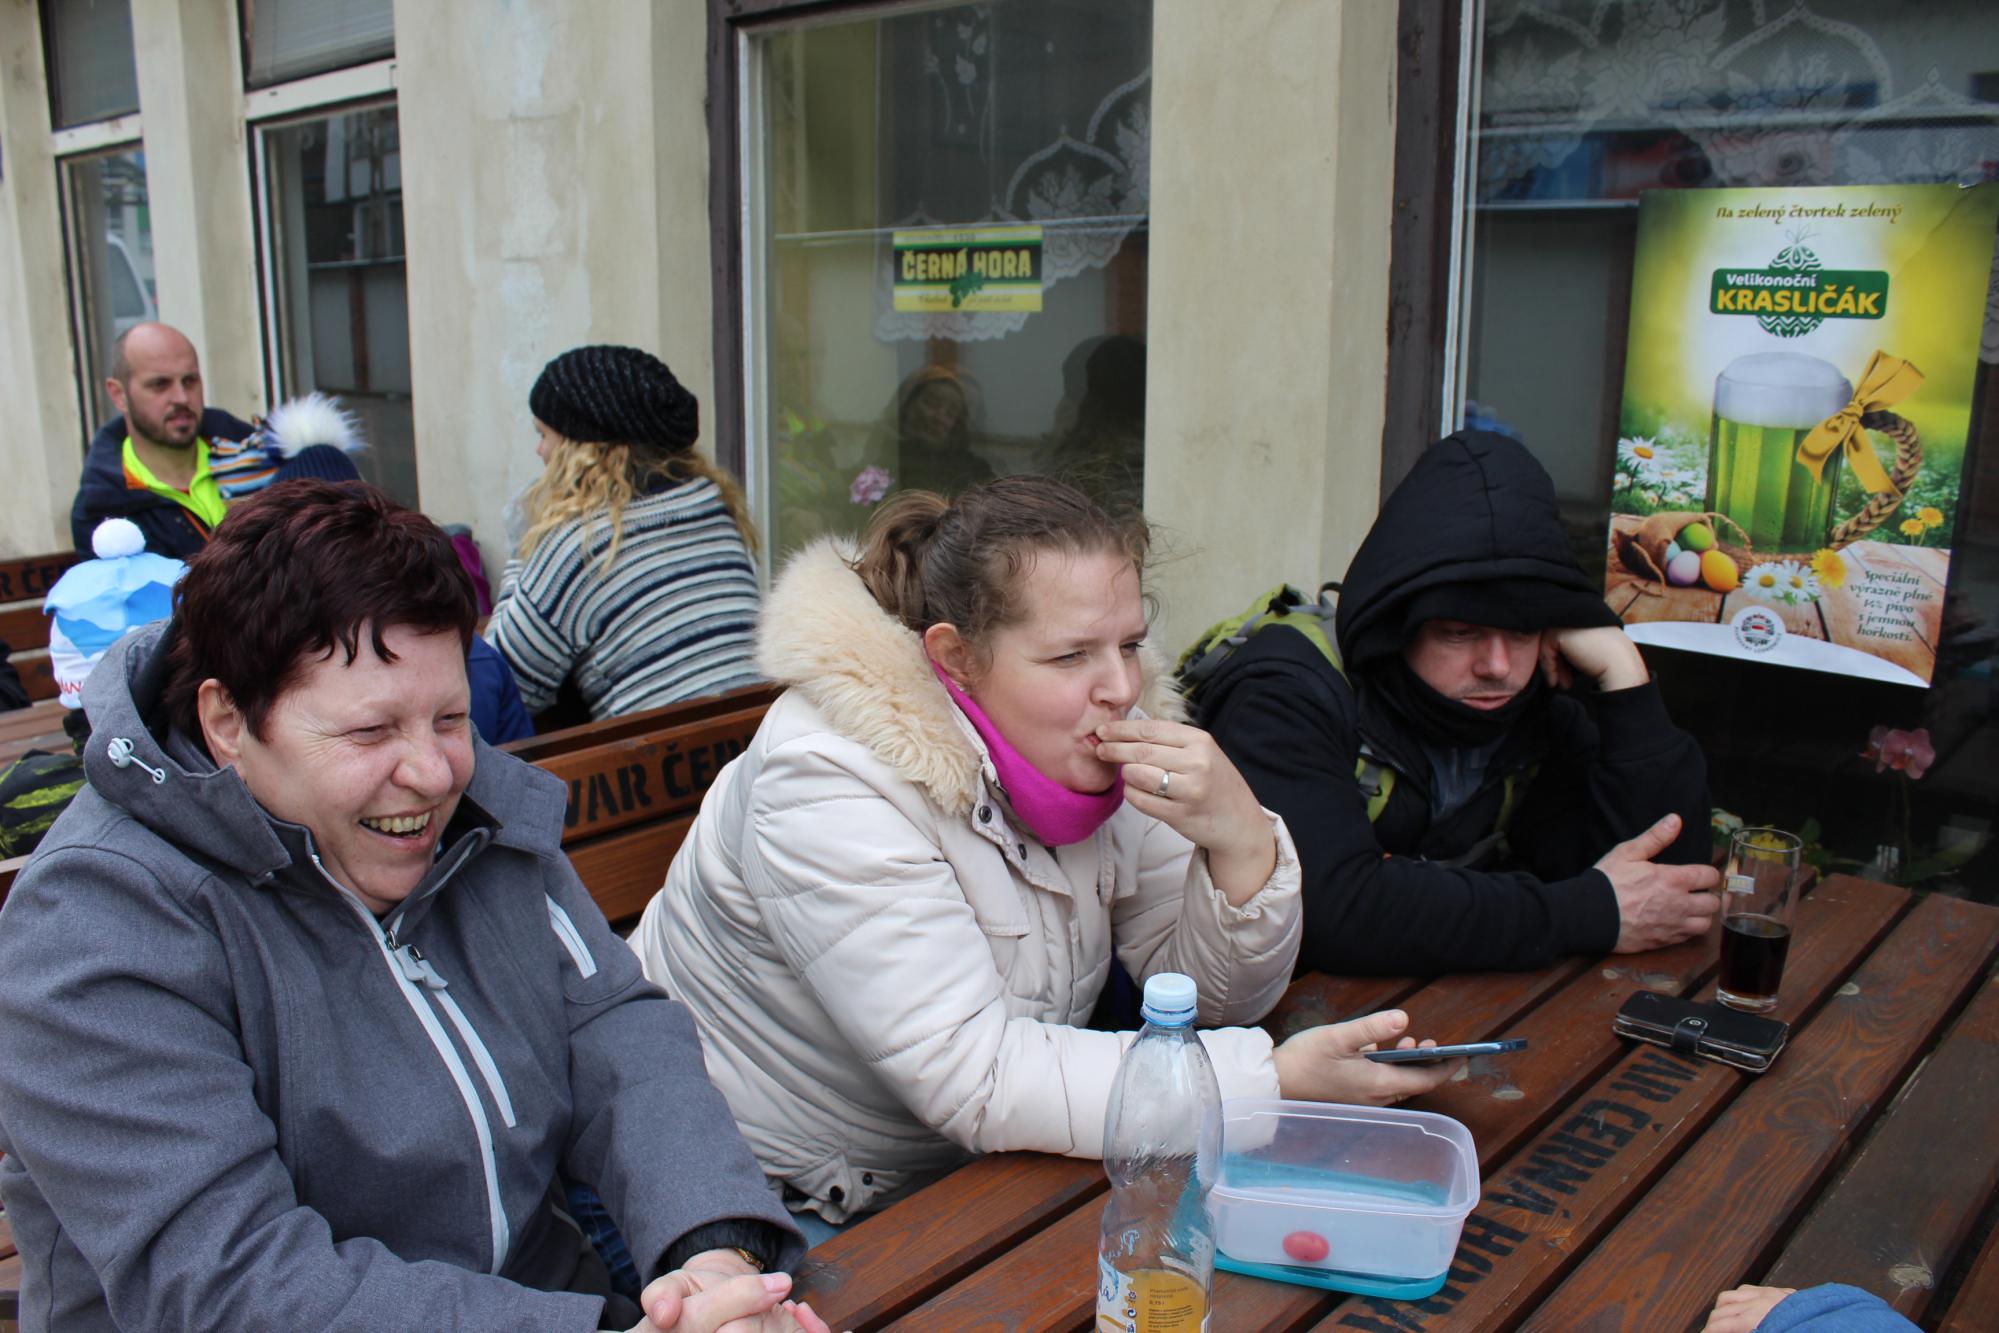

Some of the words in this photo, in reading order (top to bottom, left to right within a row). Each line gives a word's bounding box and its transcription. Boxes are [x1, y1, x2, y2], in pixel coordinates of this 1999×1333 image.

[1738, 204, 1785, 224] zelený
[1789, 203, 1846, 218] čtvrtek
[1848, 202, 1903, 224] zelený
[902, 247, 968, 280] ČERNÁ
[973, 249, 1032, 278] HORA
[1726, 273, 1817, 287] Velikonoční
[1717, 284, 1881, 315] KRASLIČÁK
[1865, 570, 1921, 585] Speciální
[1850, 583, 1900, 598] výrazně
[1885, 601, 1914, 614] pivo
[1867, 612, 1915, 627] jemnou
[1487, 1098, 1662, 1219] ČERNÁ
